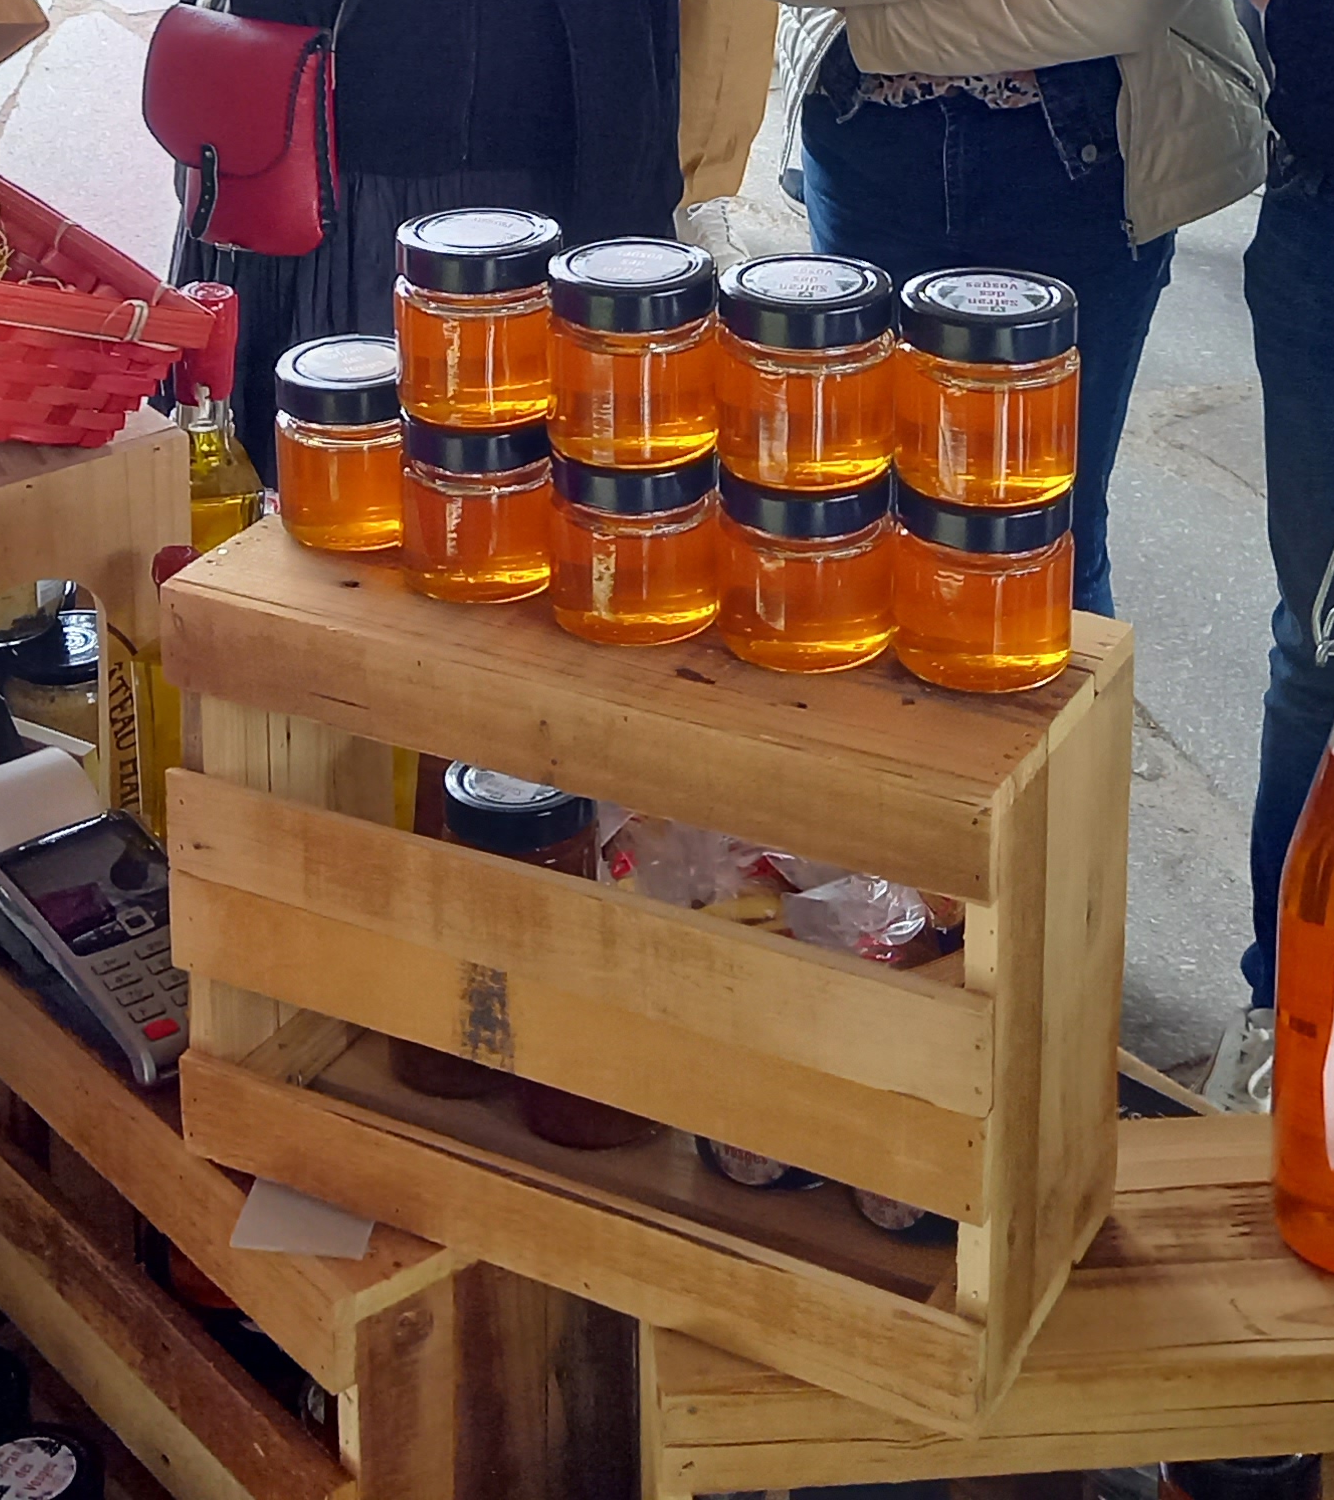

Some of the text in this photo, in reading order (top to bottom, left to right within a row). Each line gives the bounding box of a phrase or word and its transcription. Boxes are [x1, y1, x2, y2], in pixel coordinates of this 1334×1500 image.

[965, 281, 1018, 291] Vosges
[979, 290, 1006, 298] des
[967, 298, 1019, 307] Safran
